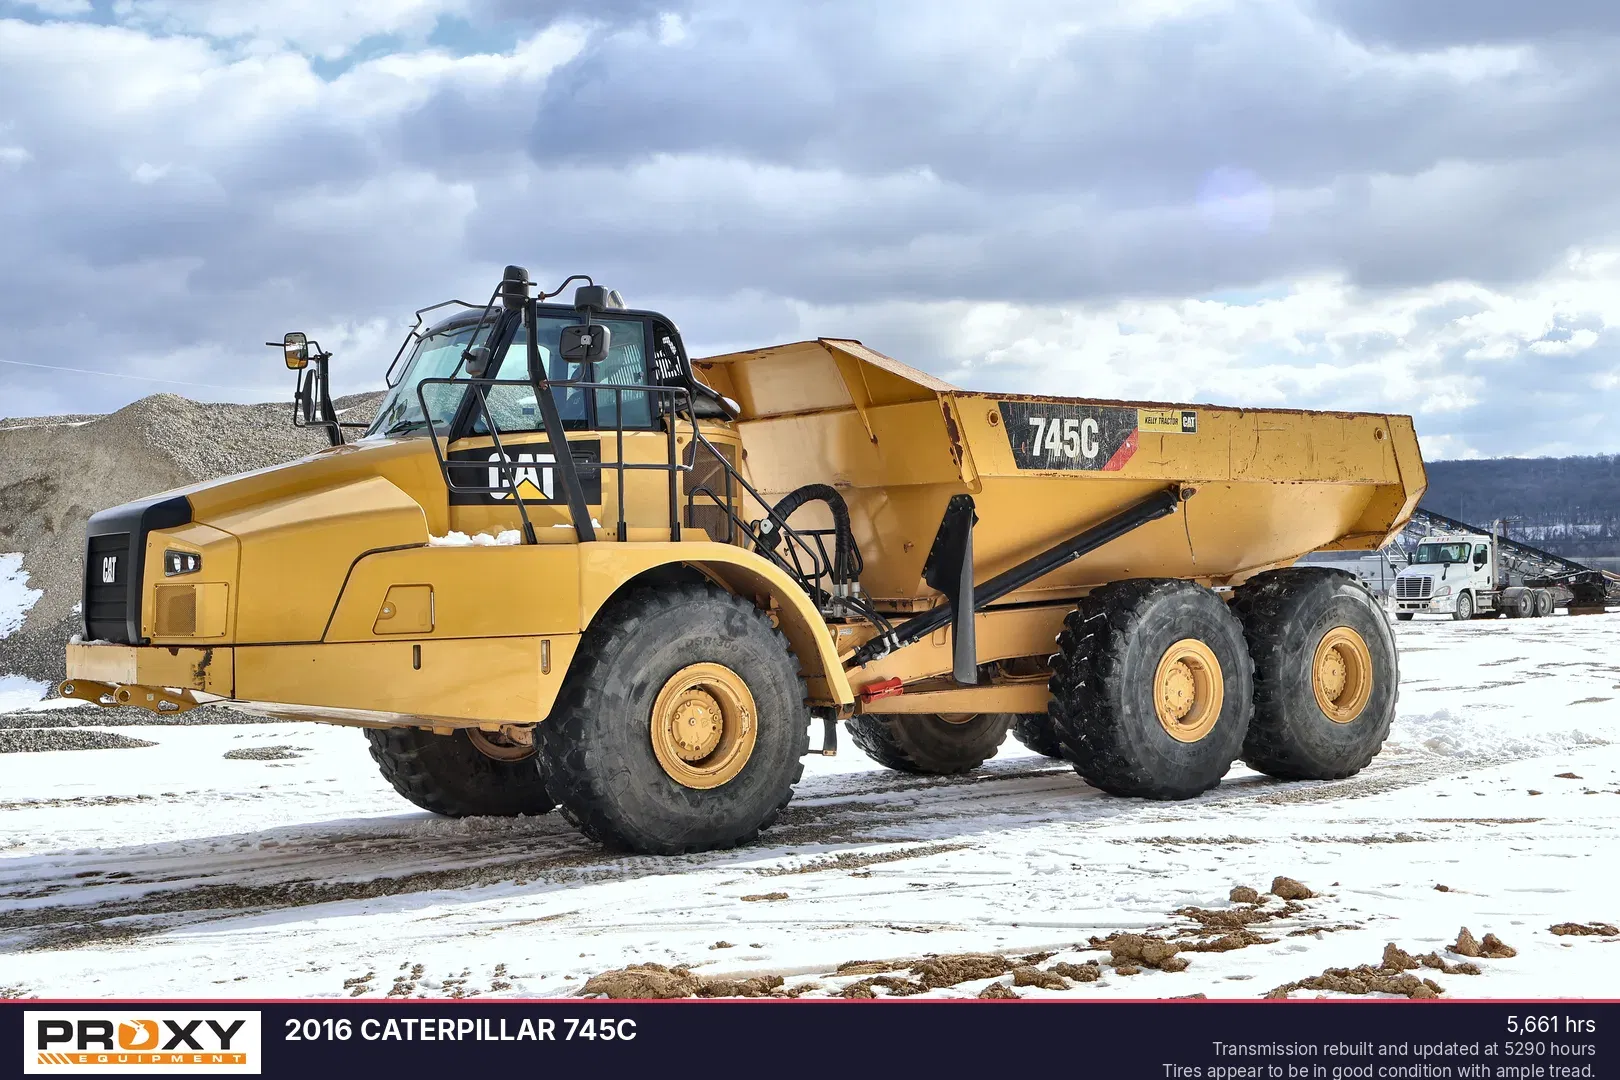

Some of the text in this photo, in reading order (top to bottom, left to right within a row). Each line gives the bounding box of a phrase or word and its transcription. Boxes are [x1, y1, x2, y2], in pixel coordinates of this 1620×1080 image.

[1144, 416, 1179, 425] KELLY TRACTOR
[1182, 416, 1195, 428] CAT
[1029, 417, 1099, 458] 745C
[488, 452, 557, 500] CAT
[103, 556, 117, 583] CAT
